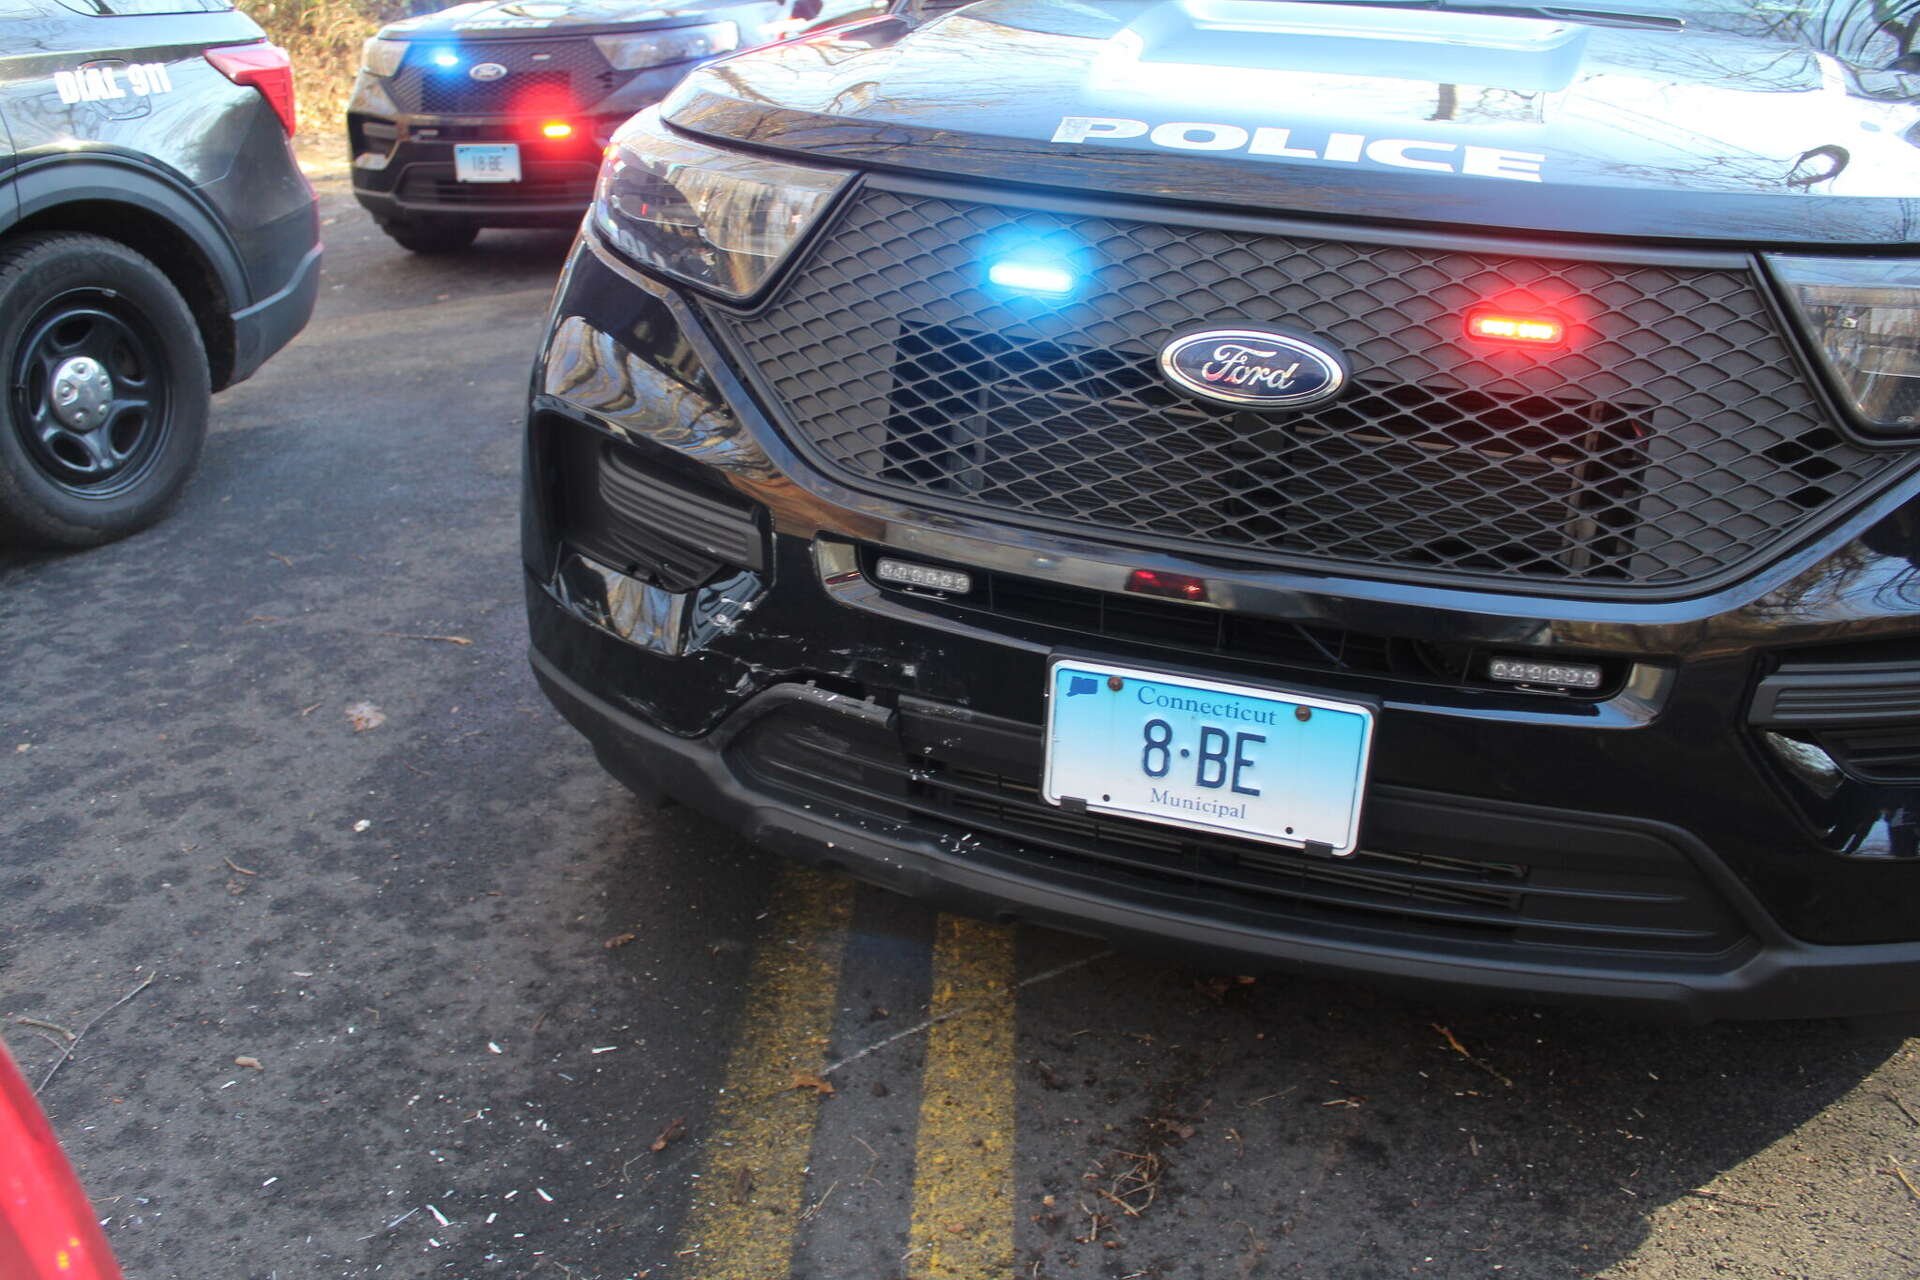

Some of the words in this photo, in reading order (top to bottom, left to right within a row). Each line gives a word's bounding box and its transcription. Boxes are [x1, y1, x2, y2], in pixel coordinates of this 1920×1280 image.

[54, 67, 126, 104] DIAL
[127, 62, 172, 97] 911
[1050, 116, 1546, 183] POLICE
[1201, 344, 1300, 390] Ford
[1137, 685, 1278, 726] Connecticut
[1150, 787, 1246, 820] Municipal
